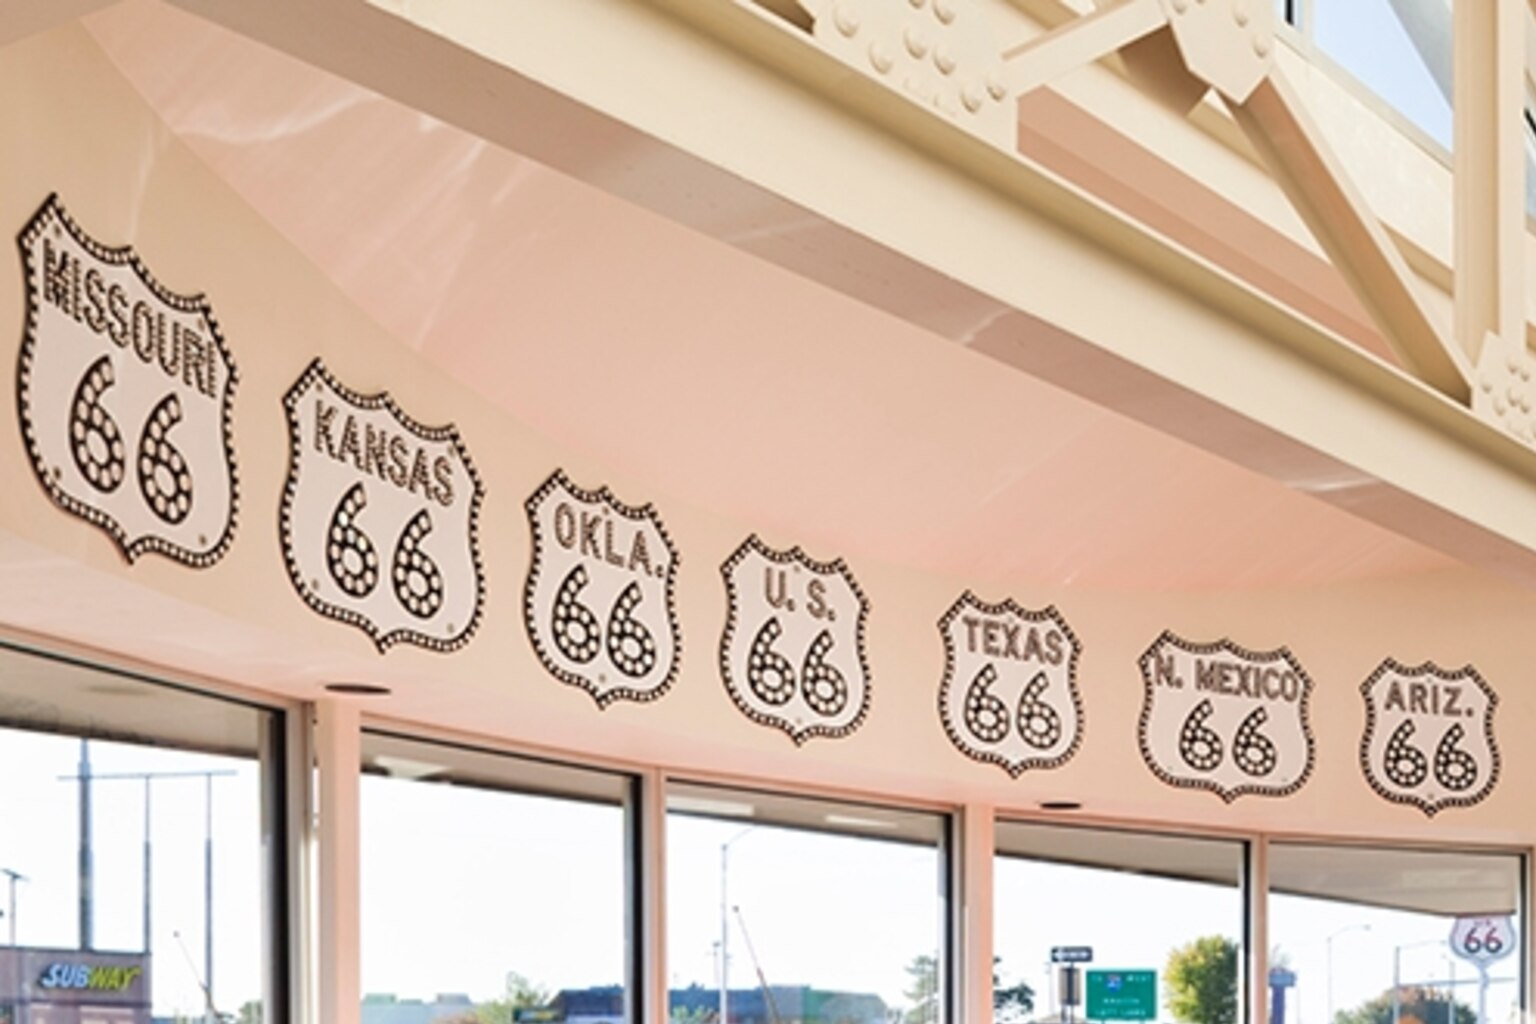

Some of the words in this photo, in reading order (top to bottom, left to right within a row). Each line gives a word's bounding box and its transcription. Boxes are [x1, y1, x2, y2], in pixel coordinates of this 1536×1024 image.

[43, 240, 218, 399] MISSOURI
[69, 354, 194, 527] 66
[313, 399, 455, 507] KANSAS
[326, 481, 444, 620] 66
[554, 503, 666, 578] OKLA.
[551, 563, 656, 679] 66
[961, 615, 1065, 668] TEXAS
[747, 616, 848, 718] 66
[963, 663, 1062, 751] 66
[1154, 655, 1183, 690] N.
[1195, 659, 1300, 702] MEXICO
[1384, 681, 1475, 718] ARIZ.
[1178, 698, 1278, 778] 66
[1382, 718, 1479, 792] 66
[42, 963, 141, 990] SUBWAY
[1464, 926, 1502, 954] 66
